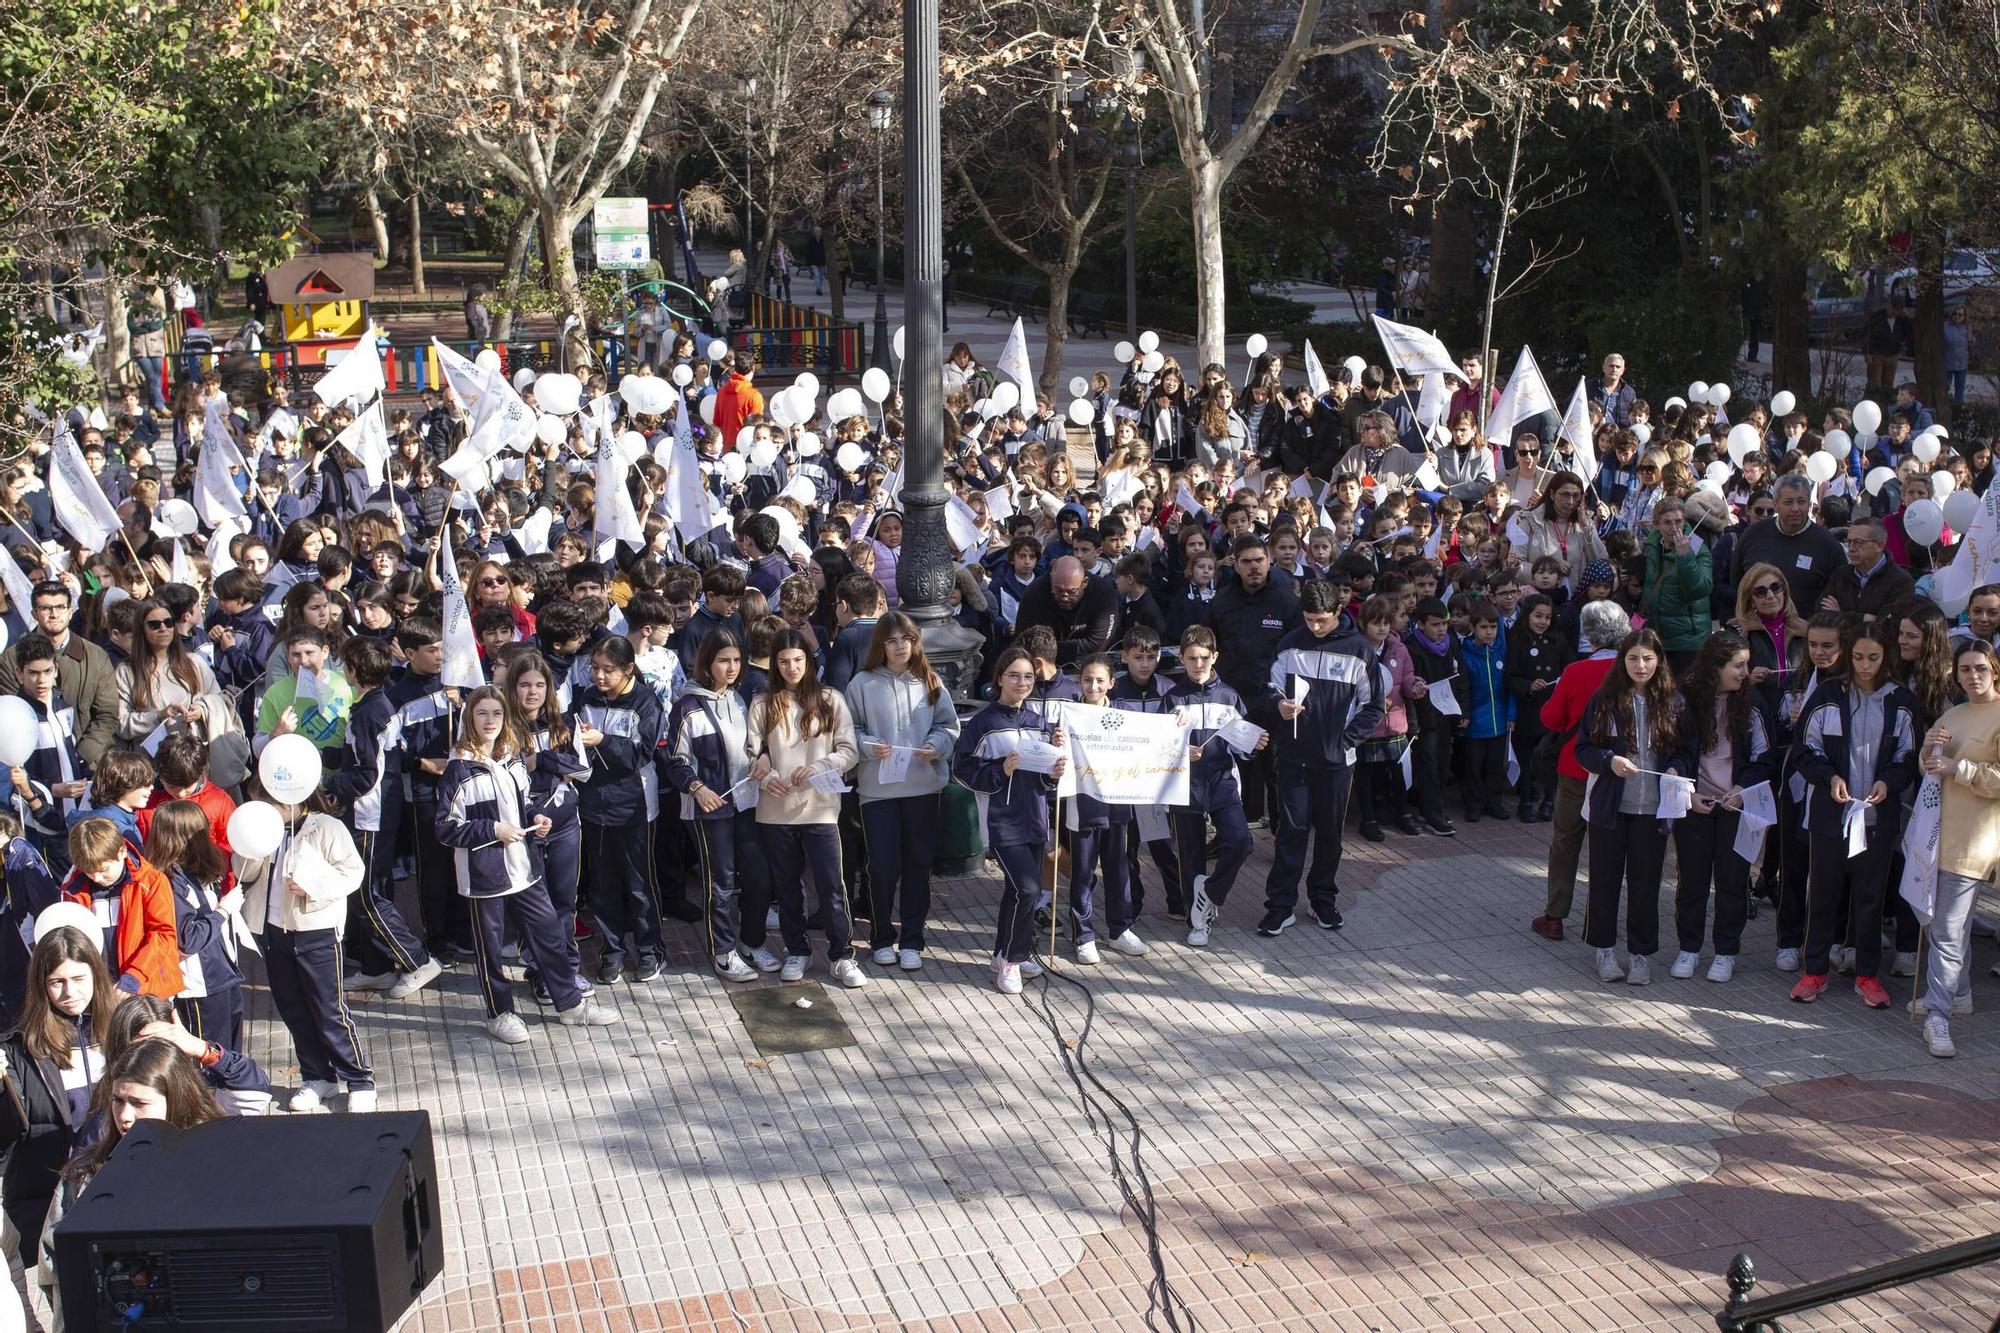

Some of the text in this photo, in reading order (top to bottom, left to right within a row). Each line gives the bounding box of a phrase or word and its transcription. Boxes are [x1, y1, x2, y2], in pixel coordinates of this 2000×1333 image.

[1070, 733, 1150, 744] escuelas católicas
[1087, 743, 1133, 751] extremadura
